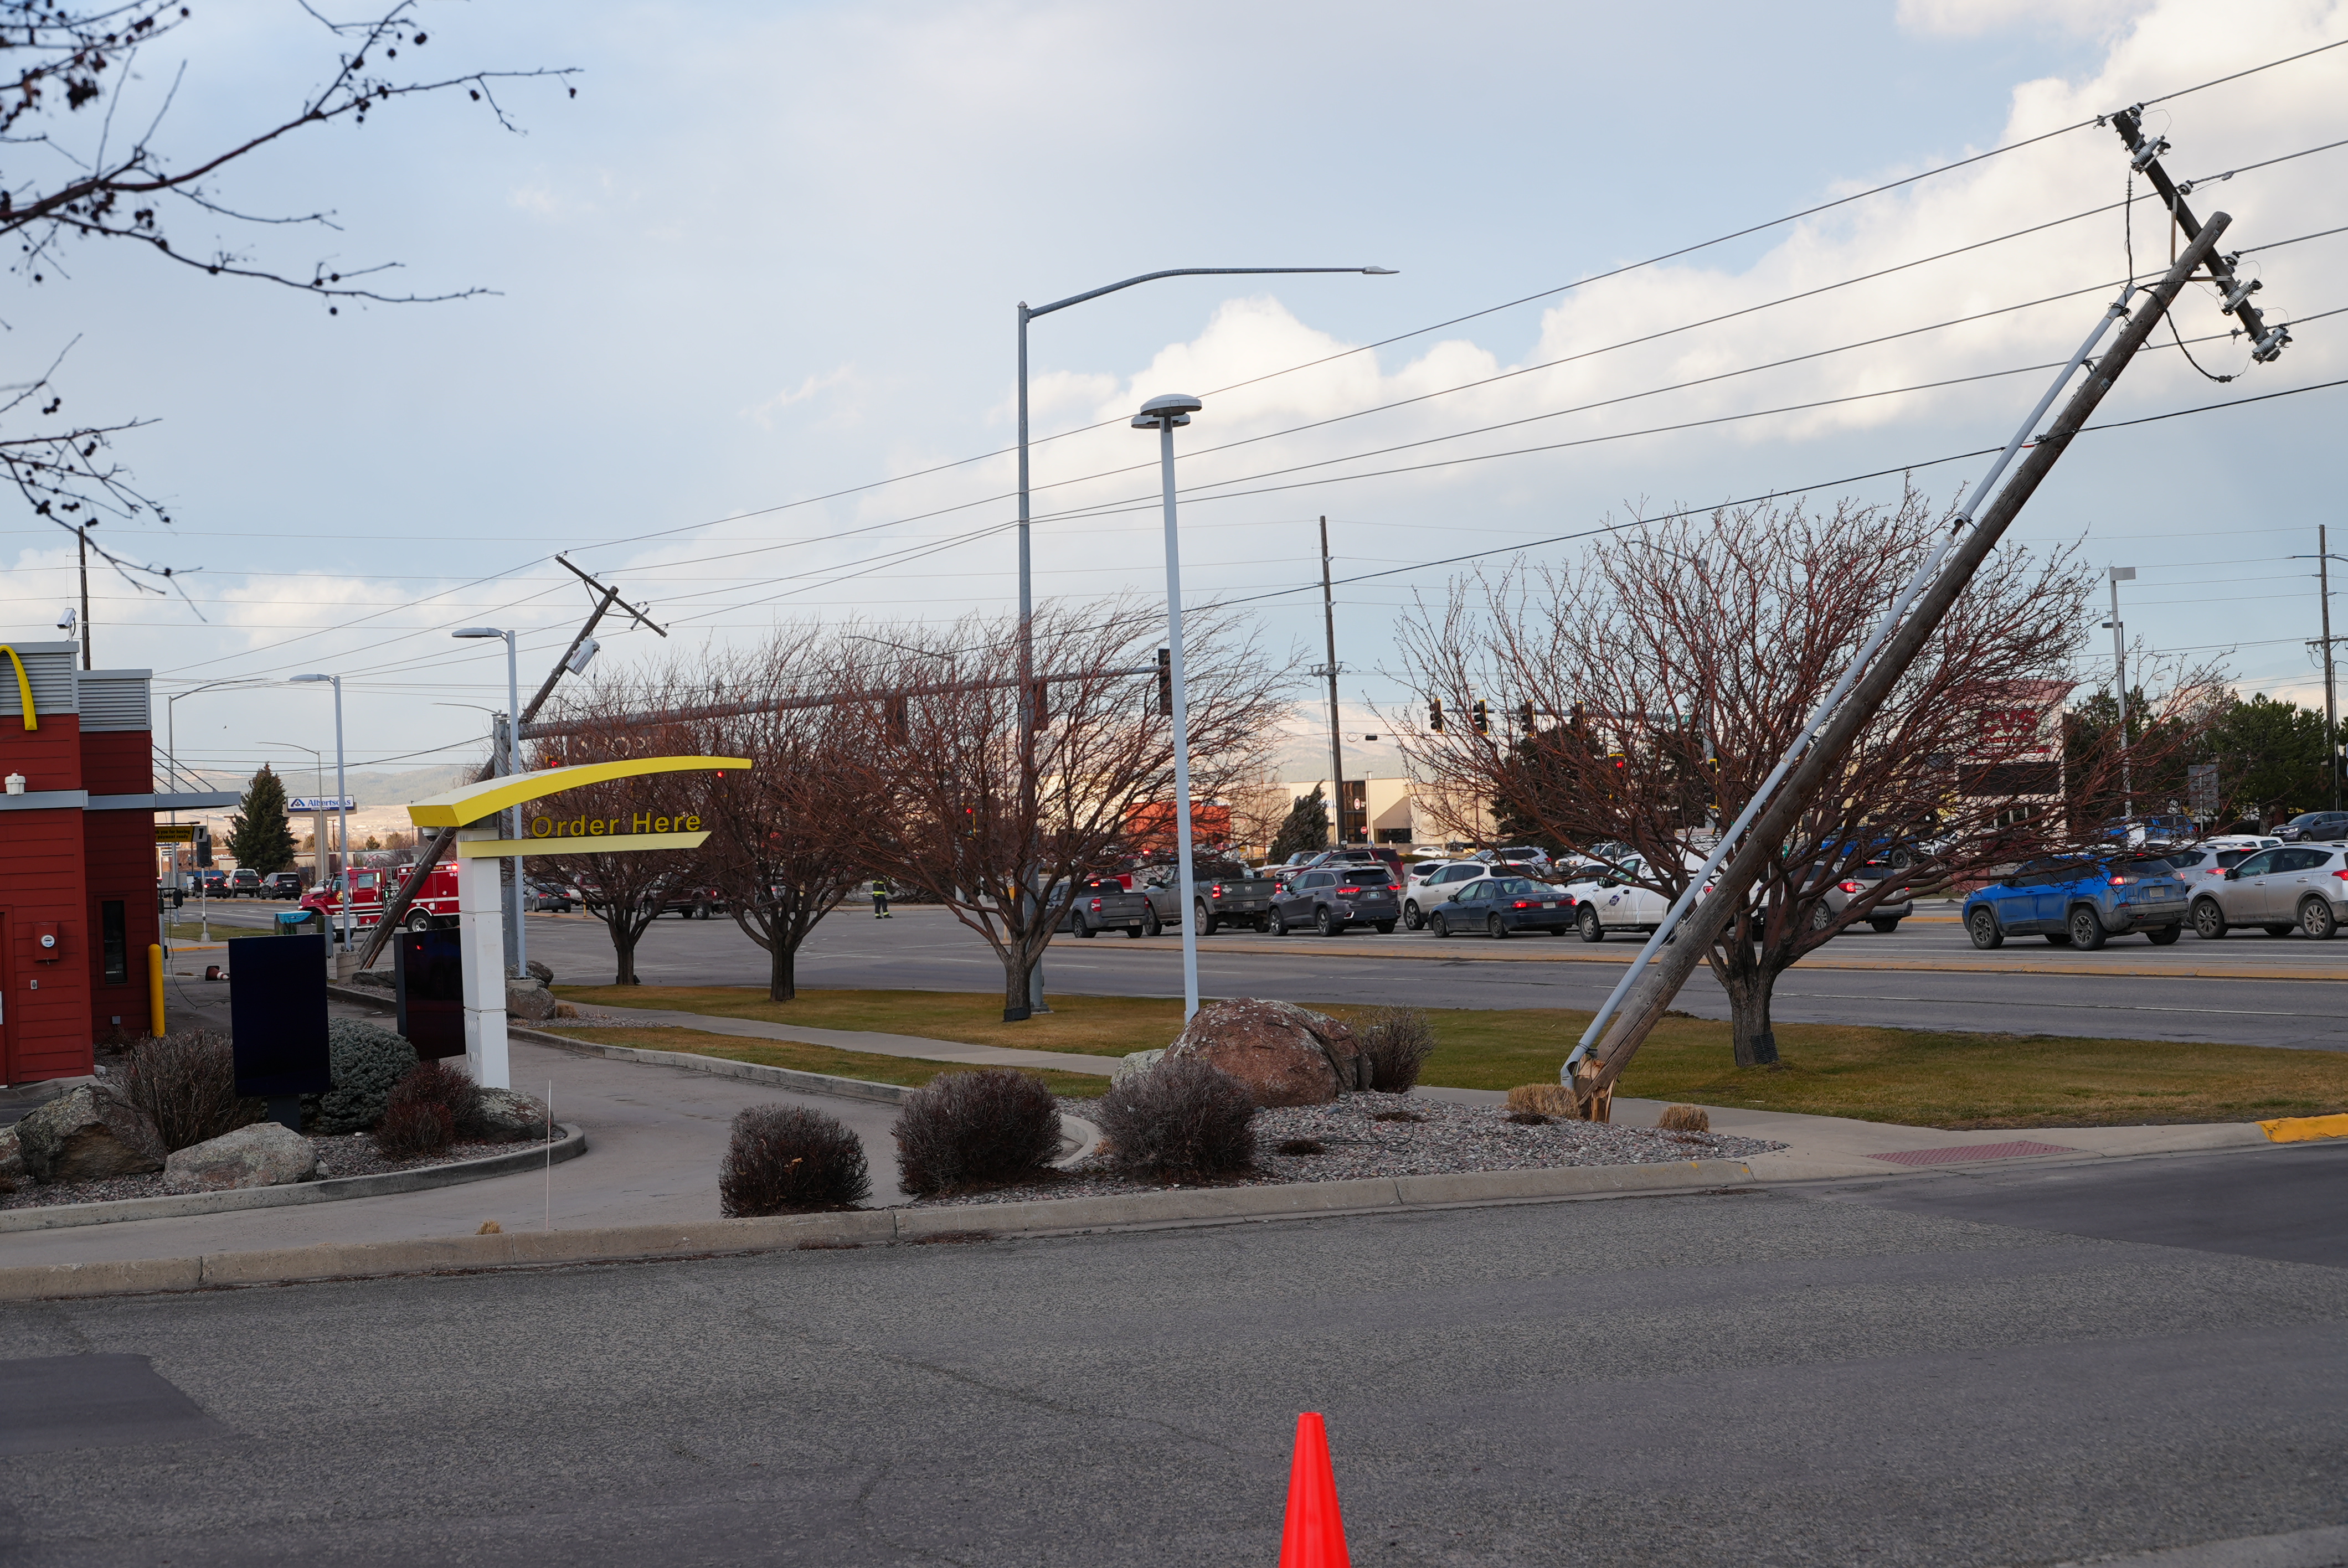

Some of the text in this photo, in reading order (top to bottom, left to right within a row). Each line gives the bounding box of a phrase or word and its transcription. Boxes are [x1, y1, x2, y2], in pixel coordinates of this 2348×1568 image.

[198, 828, 204, 839] 1
[531, 812, 701, 838] Order Here
